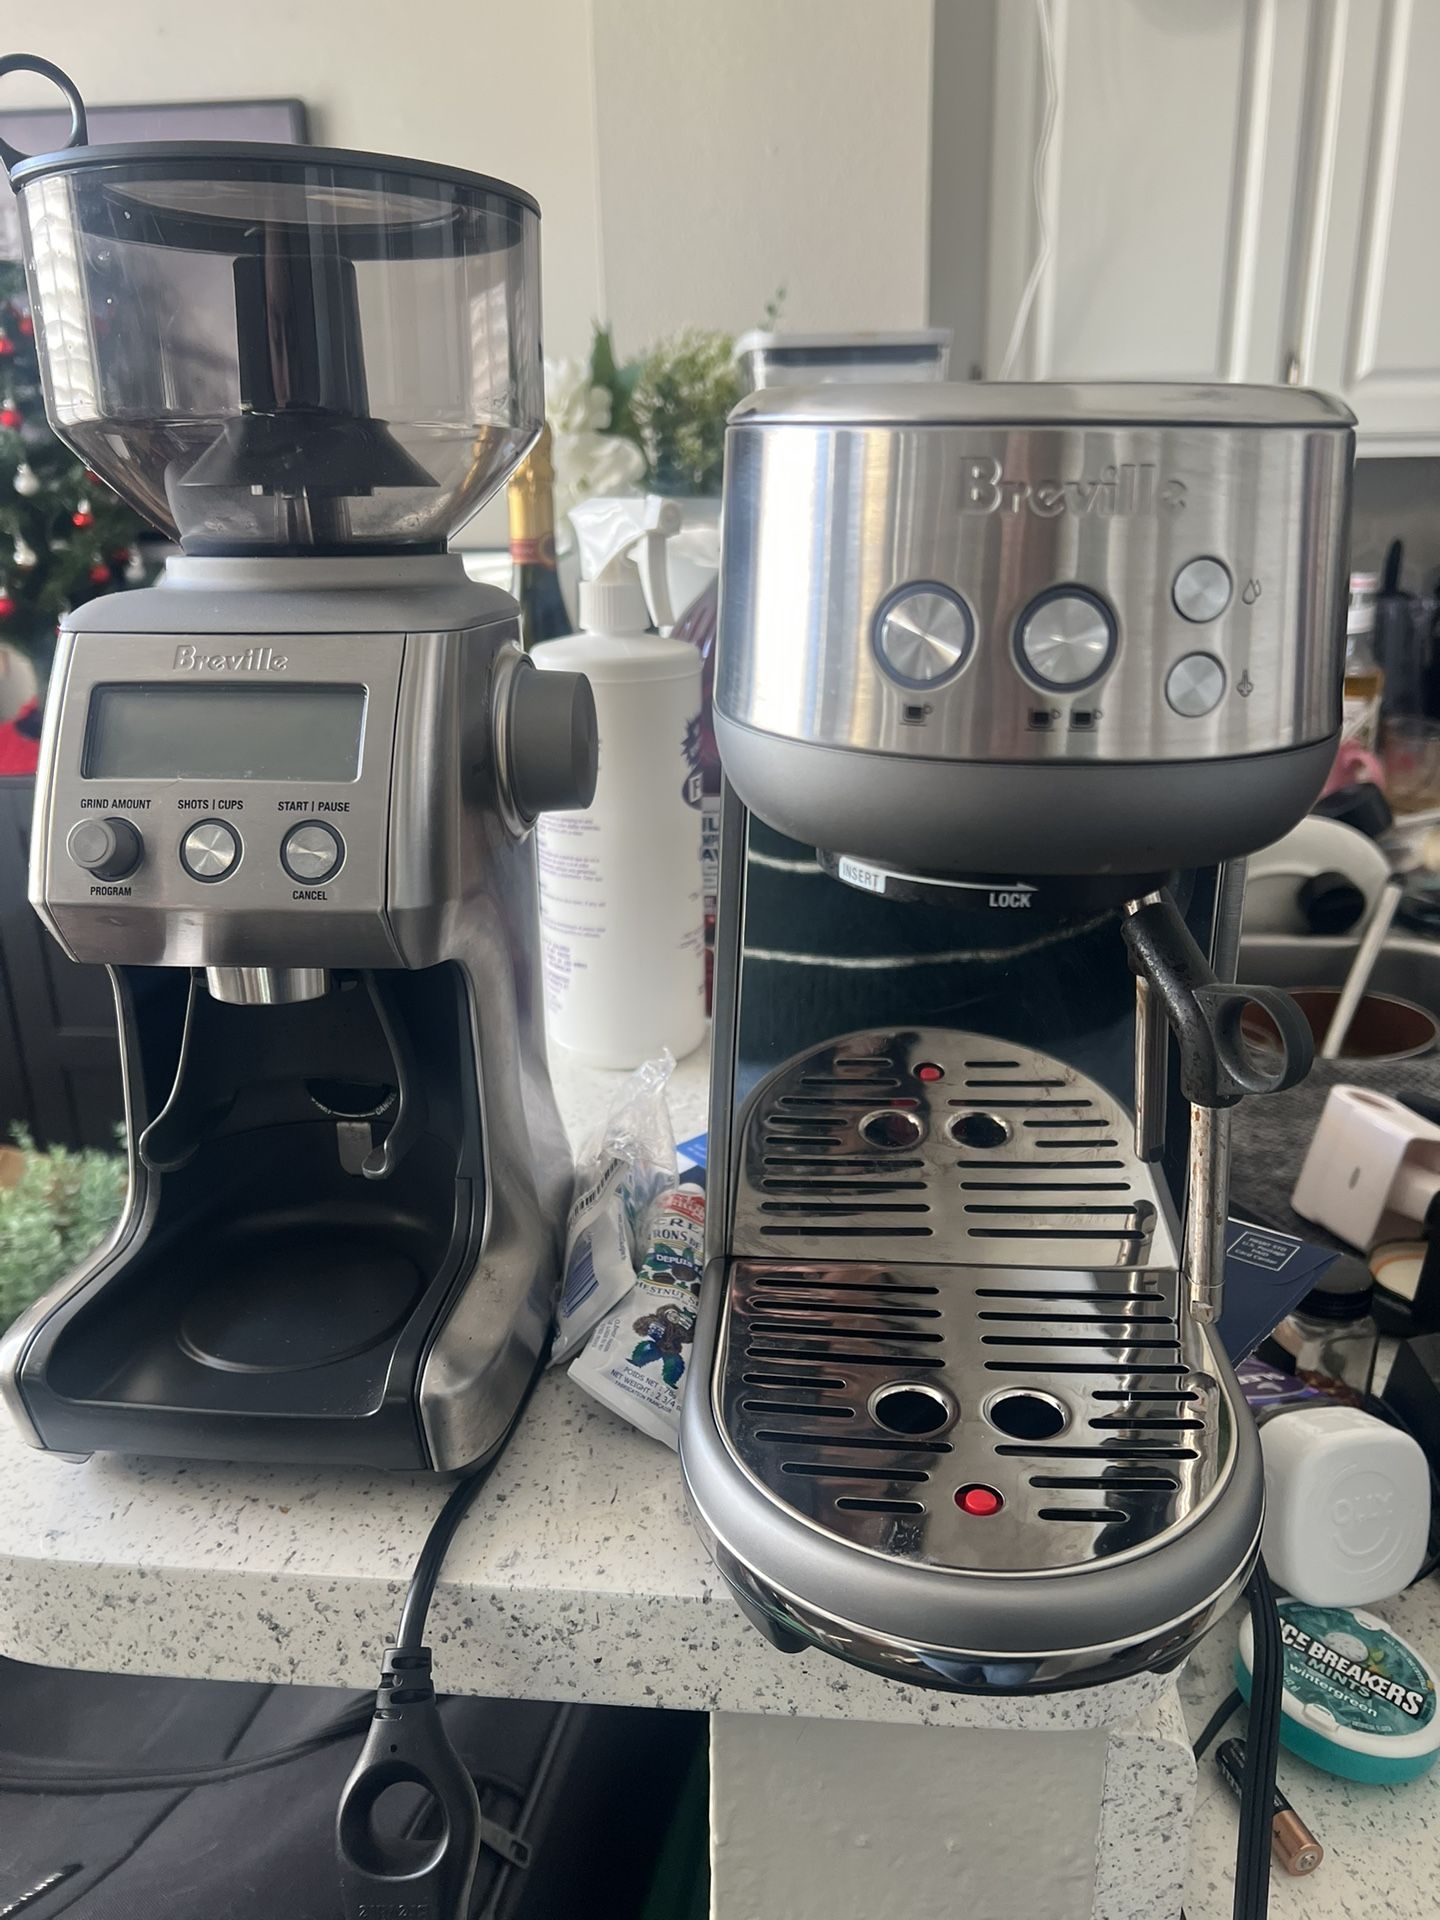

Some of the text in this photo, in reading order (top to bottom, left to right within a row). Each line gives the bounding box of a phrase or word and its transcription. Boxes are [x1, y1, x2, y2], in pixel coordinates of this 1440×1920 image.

[959, 456, 1188, 518] Breville
[172, 645, 289, 672] Breville
[80, 798, 152, 810] GRIND AMOUNT
[177, 799, 209, 810] SHOTS
[218, 800, 244, 810] CUPS
[278, 801, 310, 812] START
[318, 801, 351, 812] PAUSE
[842, 863, 880, 889] INSERT
[90, 887, 132, 897] PROGRAM
[292, 890, 328, 901] CANCEL
[988, 891, 1032, 909] LOCK
[648, 1229, 688, 1241] RONS
[656, 1254, 693, 1268] DEPUIS
[623, 1366, 645, 1381] POIDS
[645, 1377, 659, 1388] NET
[610, 1369, 624, 1380] NET
[623, 1376, 651, 1394] WEIGHT
[655, 1392, 661, 1401] 2
[661, 1396, 676, 1408] 3/4
[1279, 1618, 1311, 1651] CE
[1308, 1641, 1423, 1715] BREAKERS
[1308, 1658, 1371, 1698] MINTS
[1289, 1663, 1378, 1717] wintergreen
